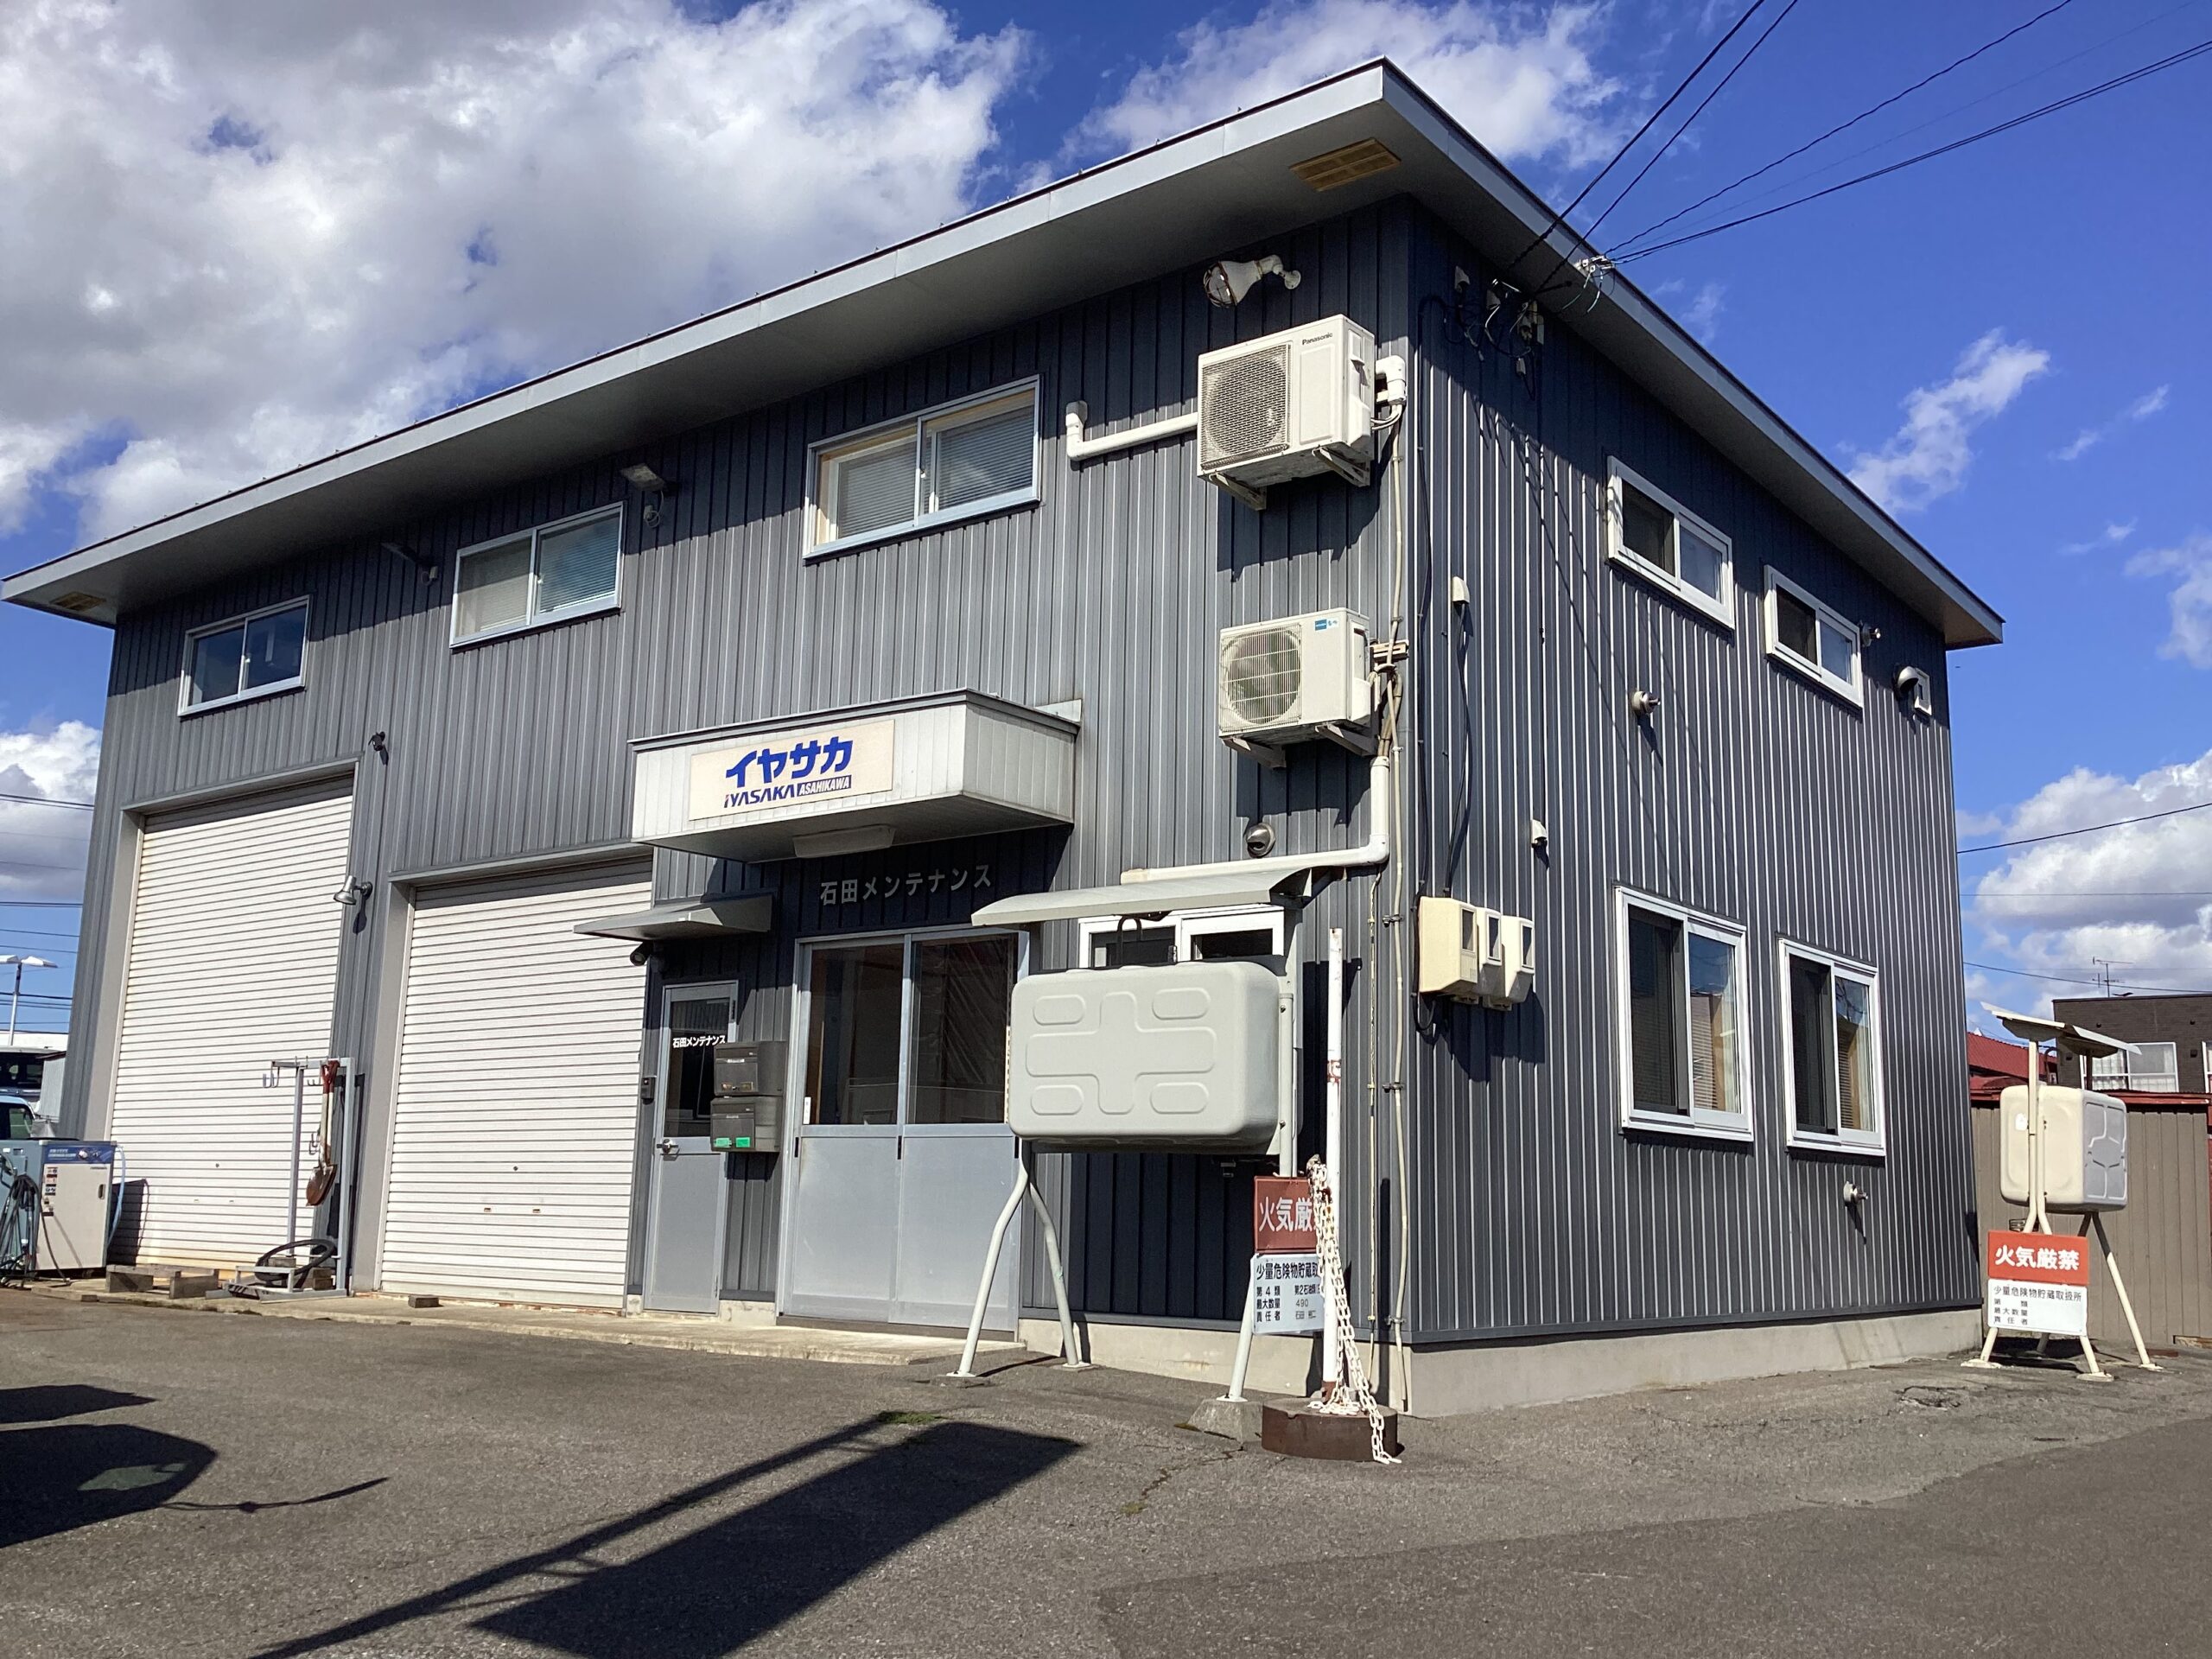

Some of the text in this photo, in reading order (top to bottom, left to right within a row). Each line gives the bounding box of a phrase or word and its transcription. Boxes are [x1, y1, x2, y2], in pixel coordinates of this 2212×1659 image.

[1302, 332, 1333, 346] Panasonic
[725, 735, 854, 788] イヤサカ
[798, 776, 850, 797] ASAHIKAWA
[820, 864, 992, 906] 石田メンテナンス
[672, 1034, 726, 1049] 石田メンテナンス
[1258, 1196, 1317, 1232] 火気厳
[1994, 1244, 2080, 1271] 火気厳禁
[1255, 1262, 1319, 1280] 少量危険物貯蔵取
[1993, 1285, 2082, 1302] 少量危険物貯蔵取扱所
[1256, 1298, 1309, 1310] 最大数量 490
